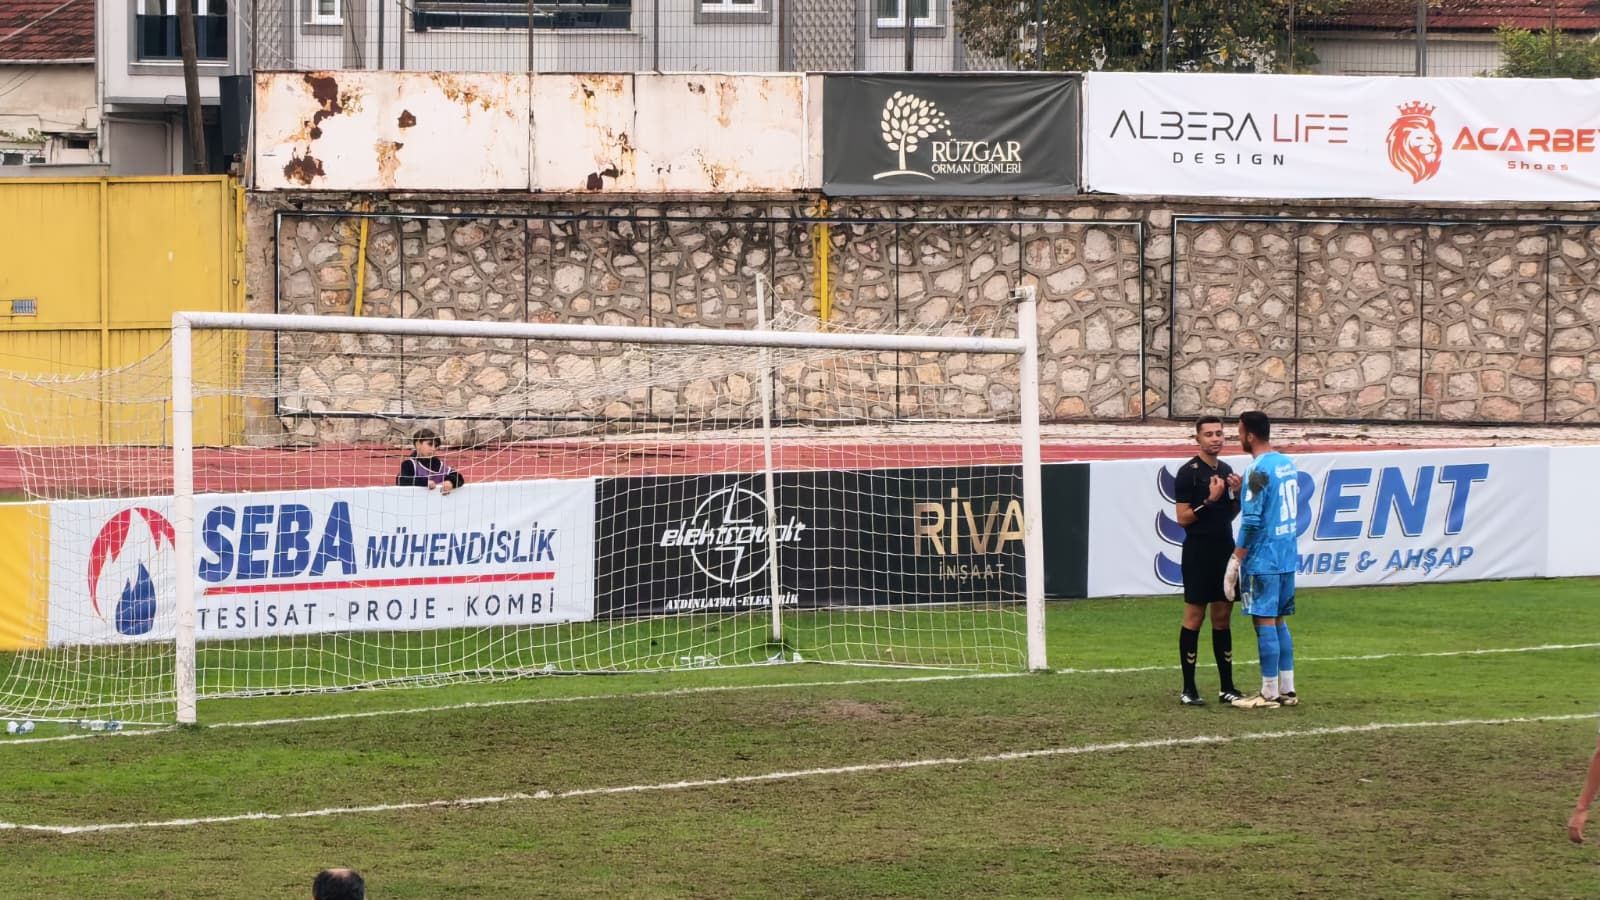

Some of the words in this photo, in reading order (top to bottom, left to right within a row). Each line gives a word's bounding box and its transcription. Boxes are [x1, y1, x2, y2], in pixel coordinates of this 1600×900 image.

[1110, 110, 1262, 142] ALBERA
[1273, 114, 1348, 143] LIFE
[1451, 126, 1600, 153] ACARBE
[931, 138, 1022, 162] RÜZGAR
[1172, 152, 1285, 166] DESIGN
[931, 163, 971, 174] ORMAN
[973, 161, 1021, 174] ÜRÜNLERİ
[1507, 160, 1569, 171] Shoes
[914, 487, 1025, 556] RİVA
[199, 501, 357, 583] SEBA
[365, 521, 556, 570] MÜHENDİSLİK
[938, 561, 1005, 585] İNŞAAT
[1355, 550, 1377, 573] &
[1382, 546, 1474, 576] AHŞAP
[197, 600, 317, 631] TESİSAT
[348, 596, 436, 620] PROJE
[466, 587, 555, 617] KOMBİ
